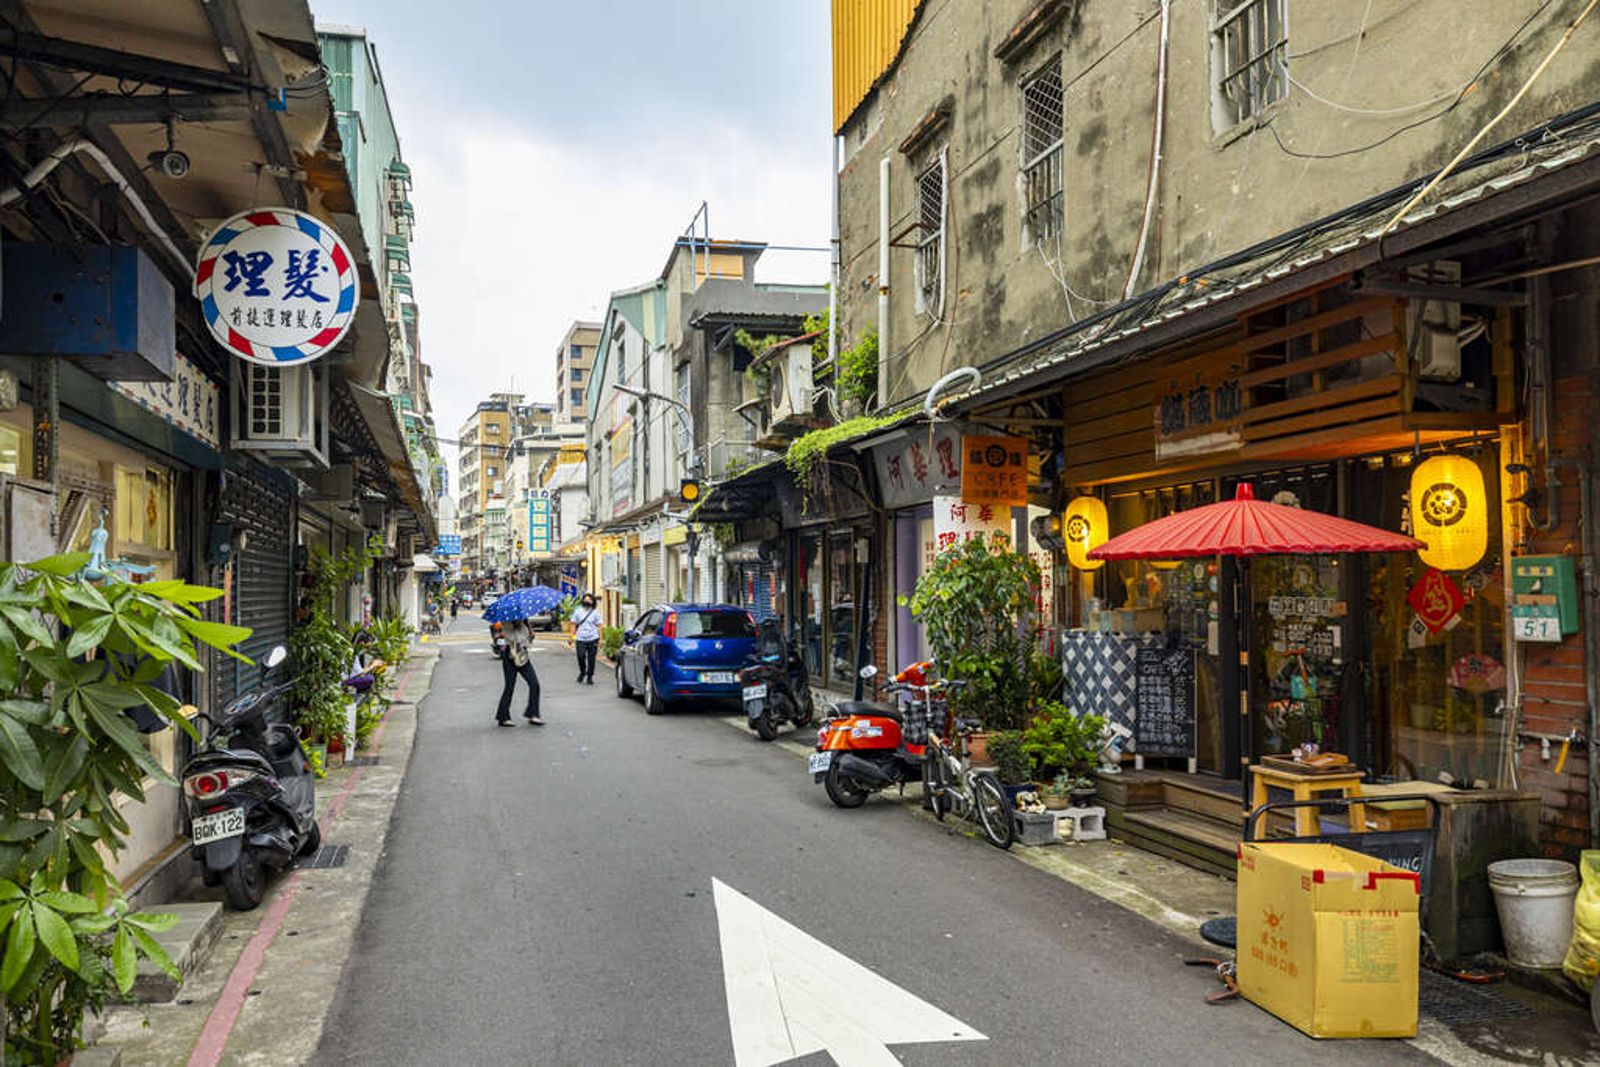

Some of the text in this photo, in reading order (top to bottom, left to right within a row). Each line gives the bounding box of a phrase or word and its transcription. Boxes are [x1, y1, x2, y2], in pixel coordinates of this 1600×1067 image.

[222, 249, 330, 302] 理髮
[230, 306, 323, 329] 前捷運理髮店
[1523, 620, 1547, 638] 51
